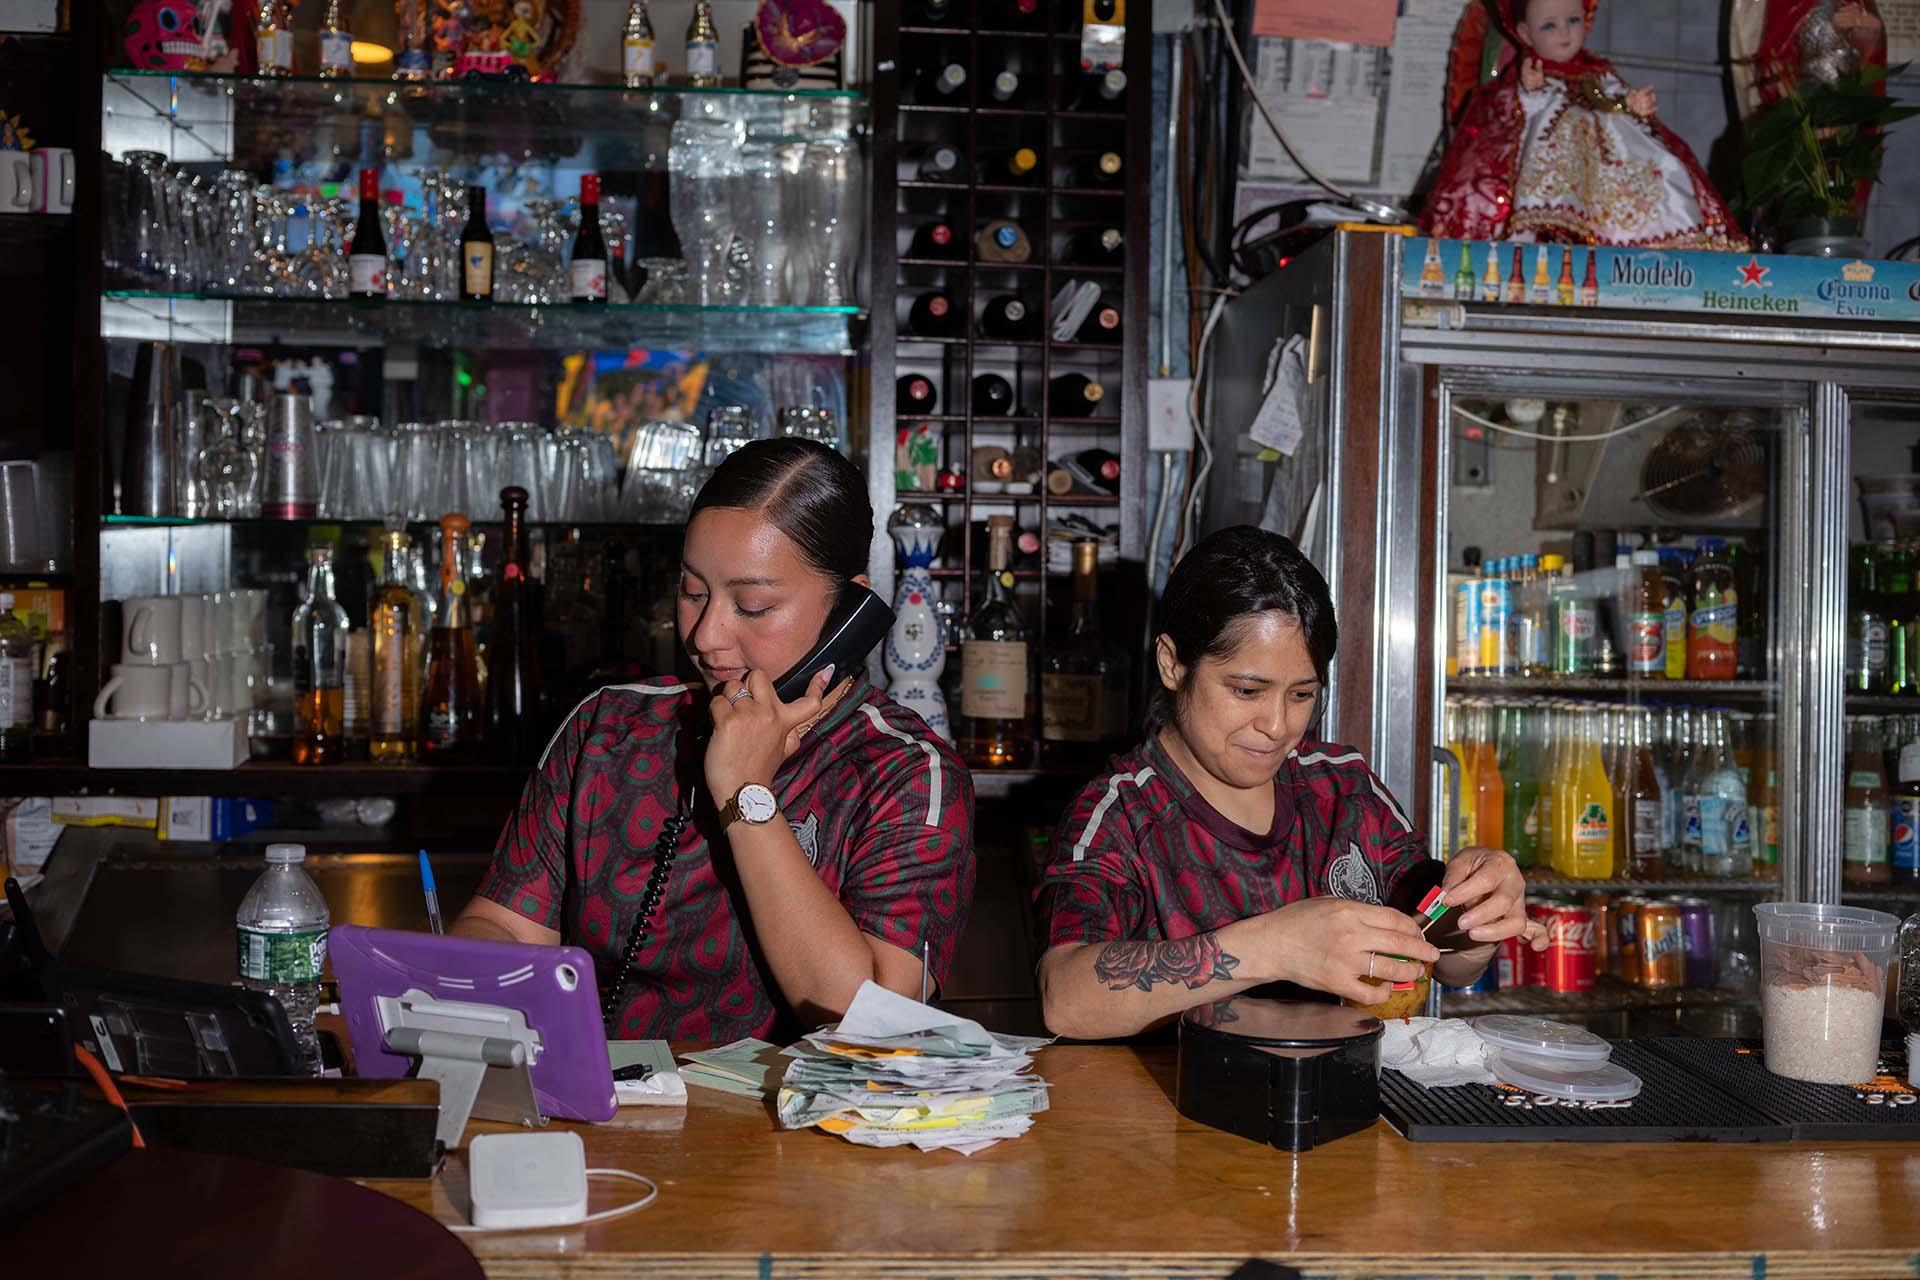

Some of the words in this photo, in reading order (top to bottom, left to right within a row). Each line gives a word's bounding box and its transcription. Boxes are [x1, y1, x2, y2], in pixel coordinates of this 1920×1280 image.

[1611, 256, 1693, 287] Modelo
[1702, 290, 1799, 312] Heineken
[1817, 279, 1890, 302] Corona
[1836, 302, 1876, 316] Extra
